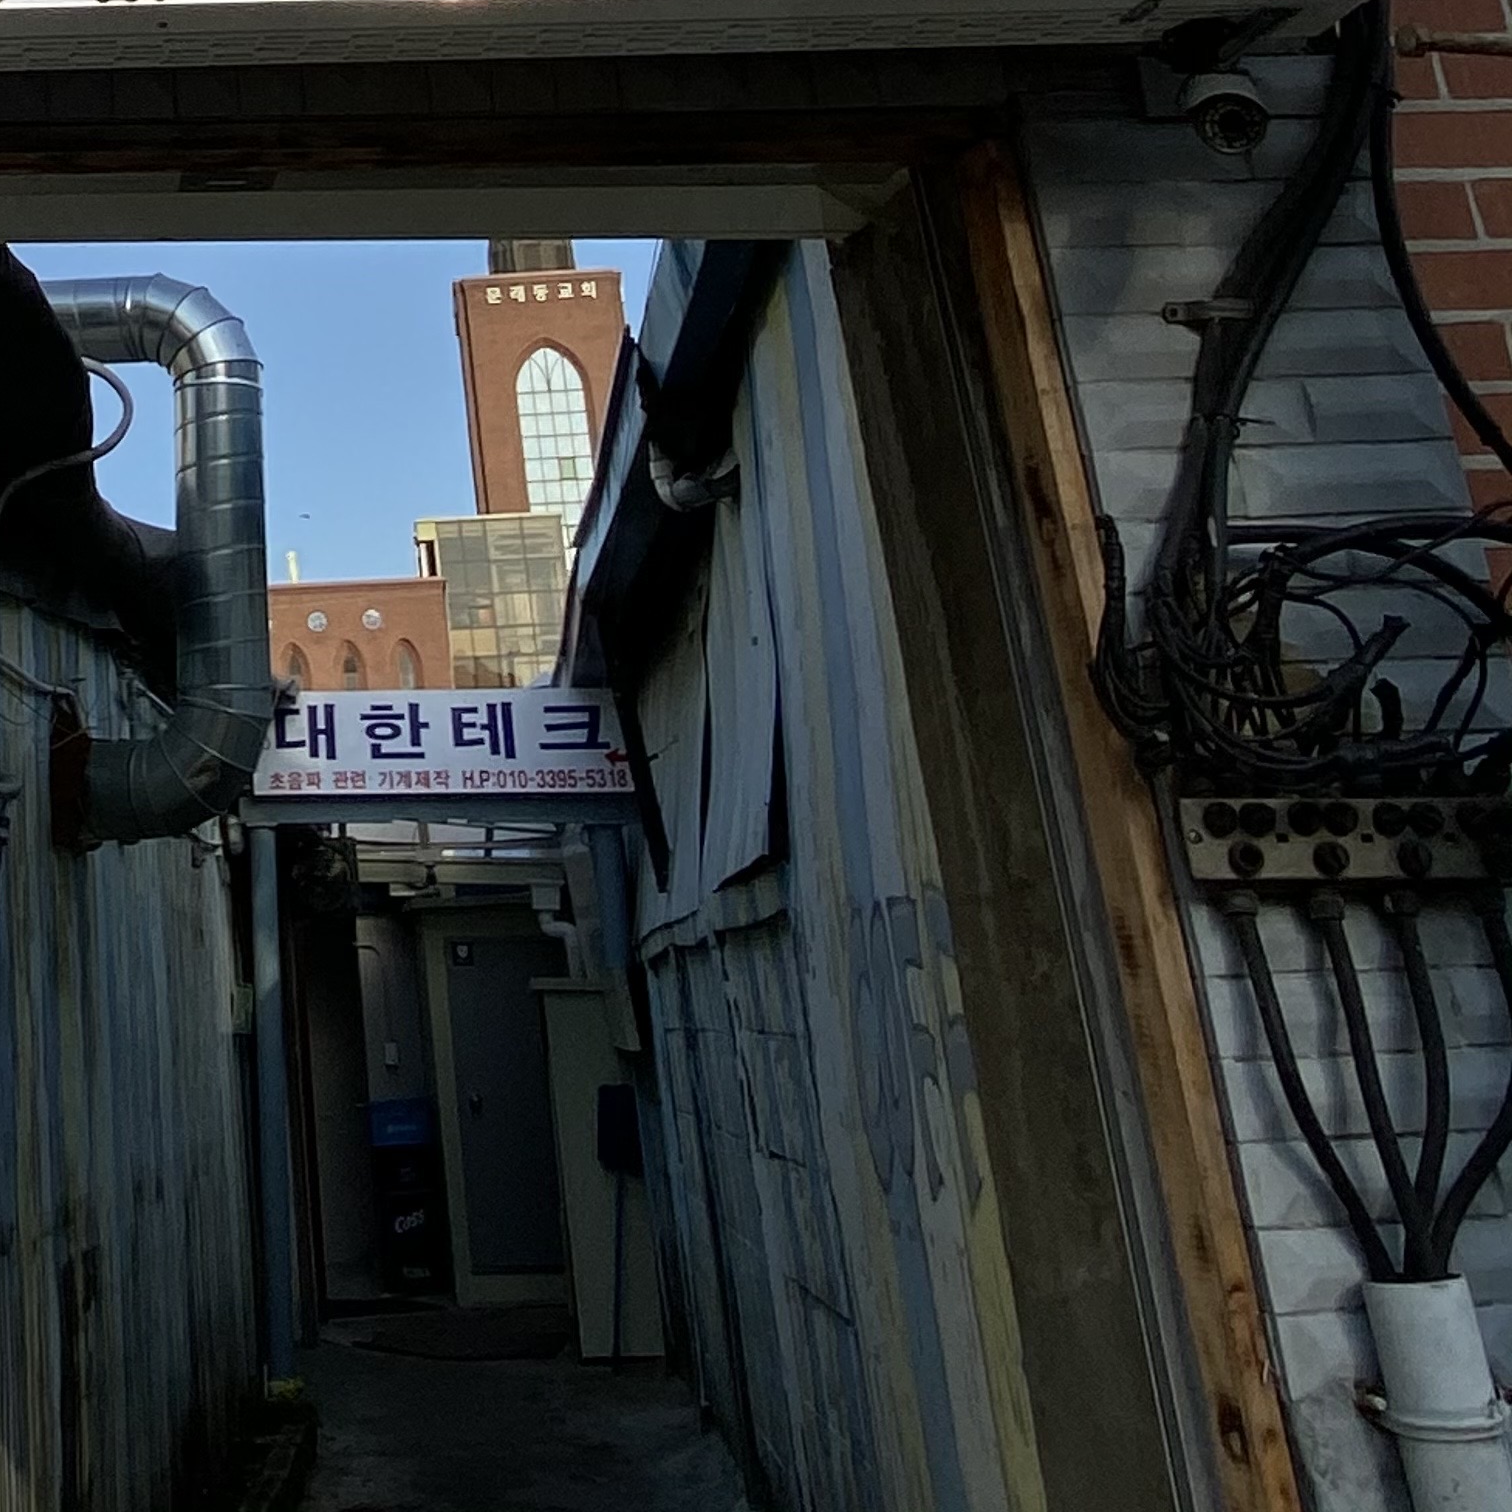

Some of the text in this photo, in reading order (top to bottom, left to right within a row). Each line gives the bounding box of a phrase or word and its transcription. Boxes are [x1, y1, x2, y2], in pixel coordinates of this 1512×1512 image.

[274, 700, 612, 761] 대한테크
[268, 770, 322, 790] 초음파
[332, 770, 367, 790] 관련
[378, 769, 450, 790] 기계제작
